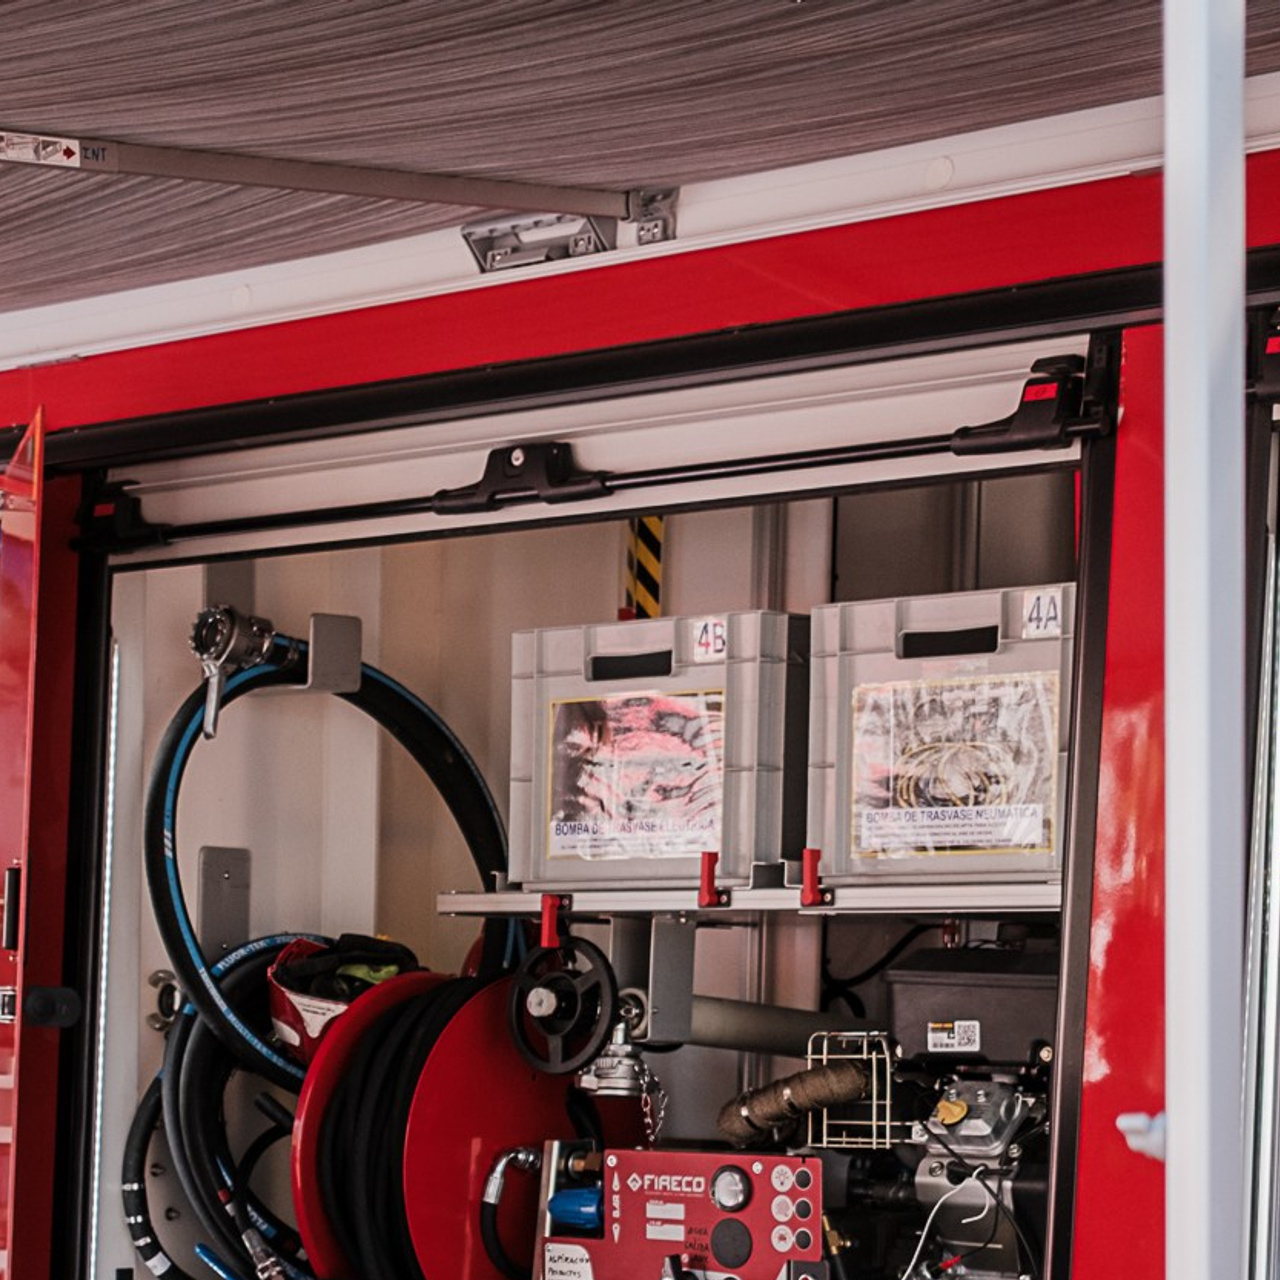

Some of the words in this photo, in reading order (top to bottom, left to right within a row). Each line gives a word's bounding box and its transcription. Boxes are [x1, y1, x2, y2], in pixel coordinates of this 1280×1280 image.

[1027, 596, 1059, 631] 4A
[697, 621, 726, 655] 4B
[904, 811, 918, 823] DE
[920, 808, 973, 822] TRASVASE
[554, 823, 590, 836] BOMBA
[643, 1174, 705, 1193] FIRECO
